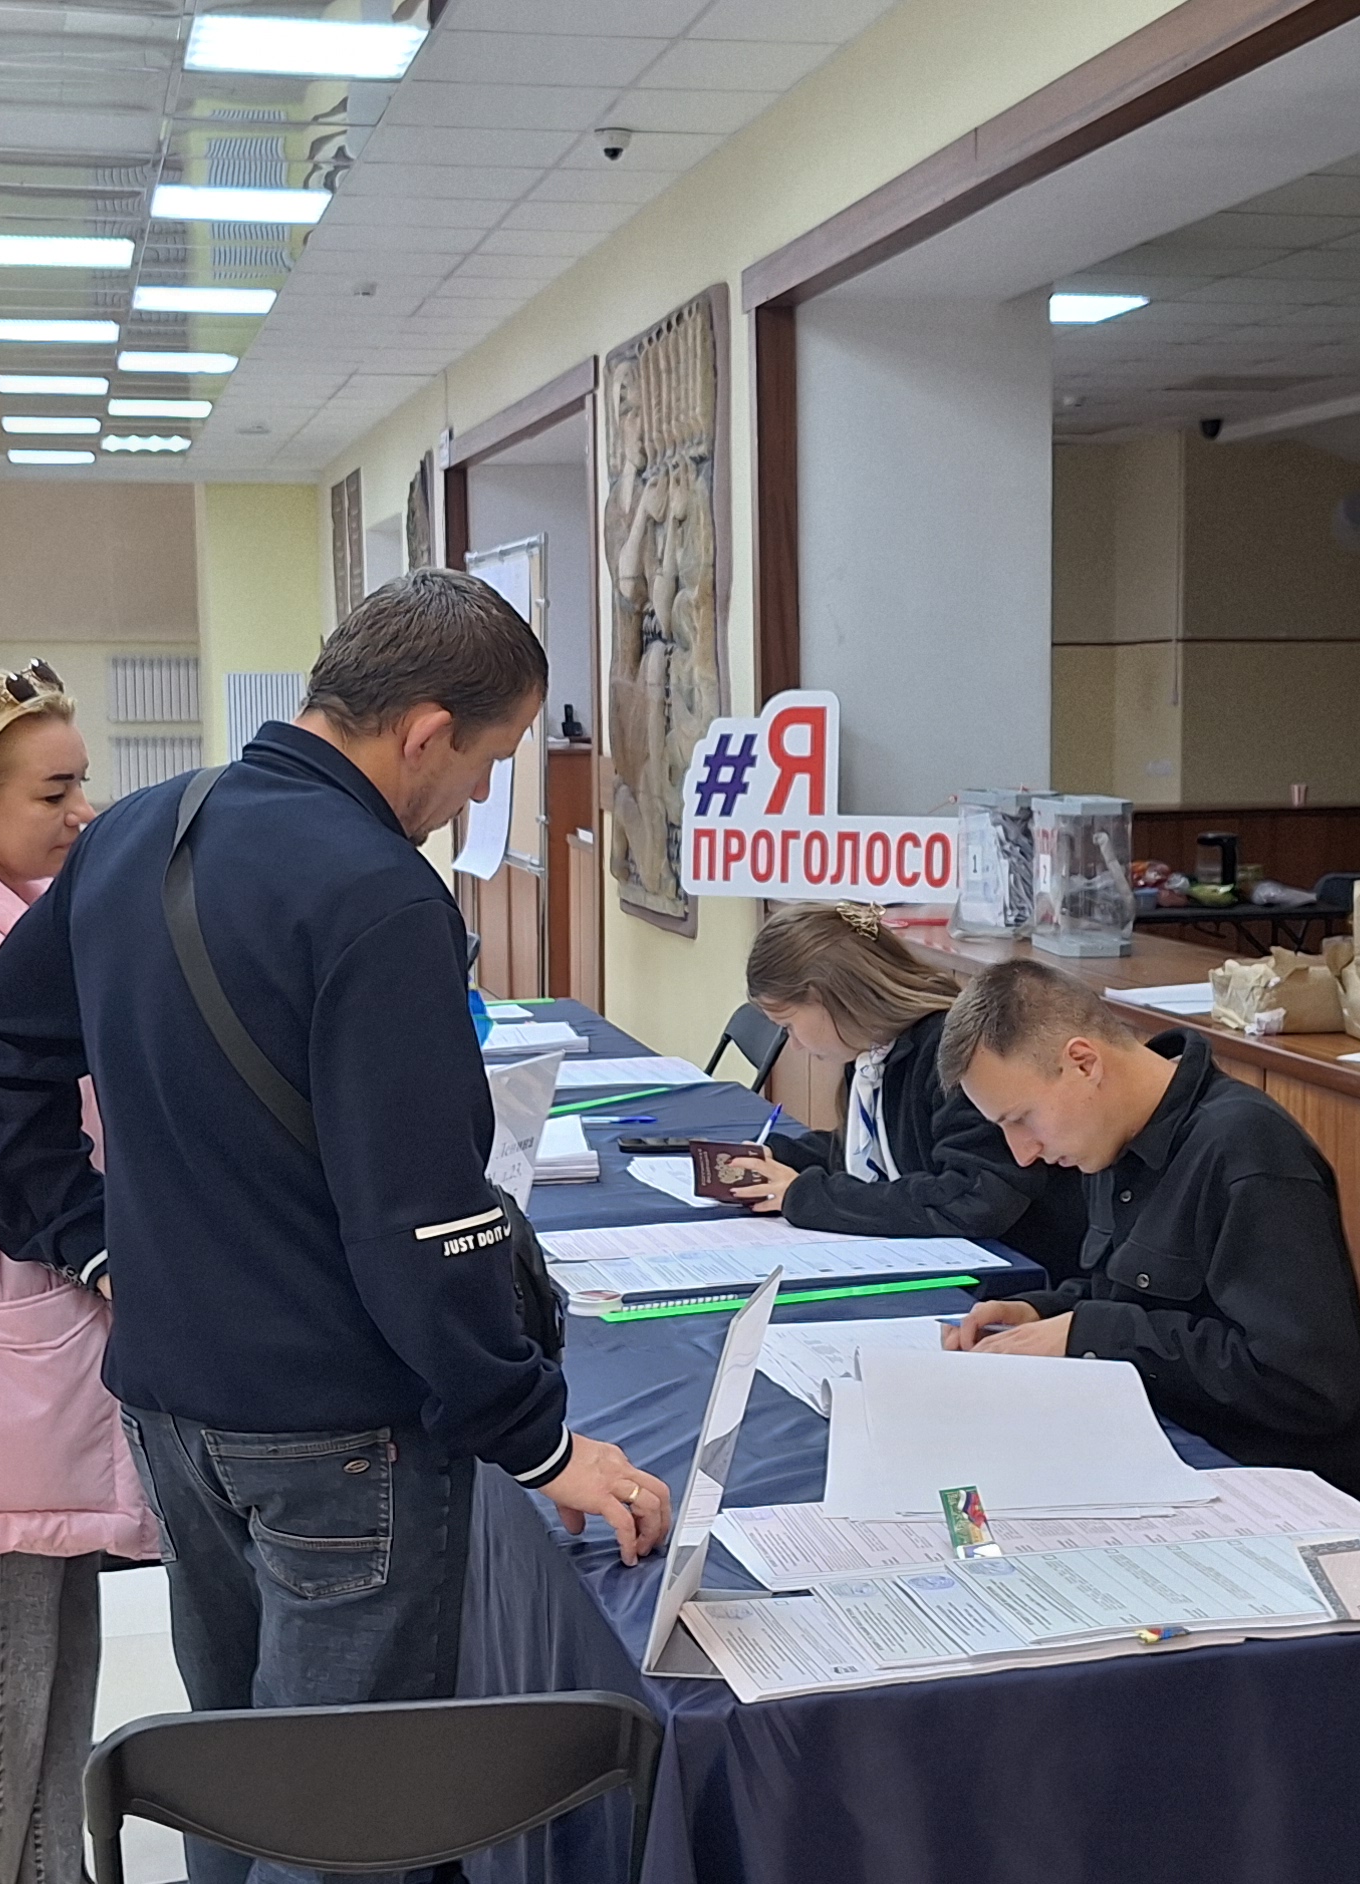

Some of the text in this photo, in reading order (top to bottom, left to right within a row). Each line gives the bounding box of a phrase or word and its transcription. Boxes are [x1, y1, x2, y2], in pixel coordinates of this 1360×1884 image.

[692, 828, 959, 889] ПРОГОЛОСО
[973, 854, 978, 874] 1
[443, 1235, 475, 1257] JUST
[476, 1230, 495, 1248] DO
